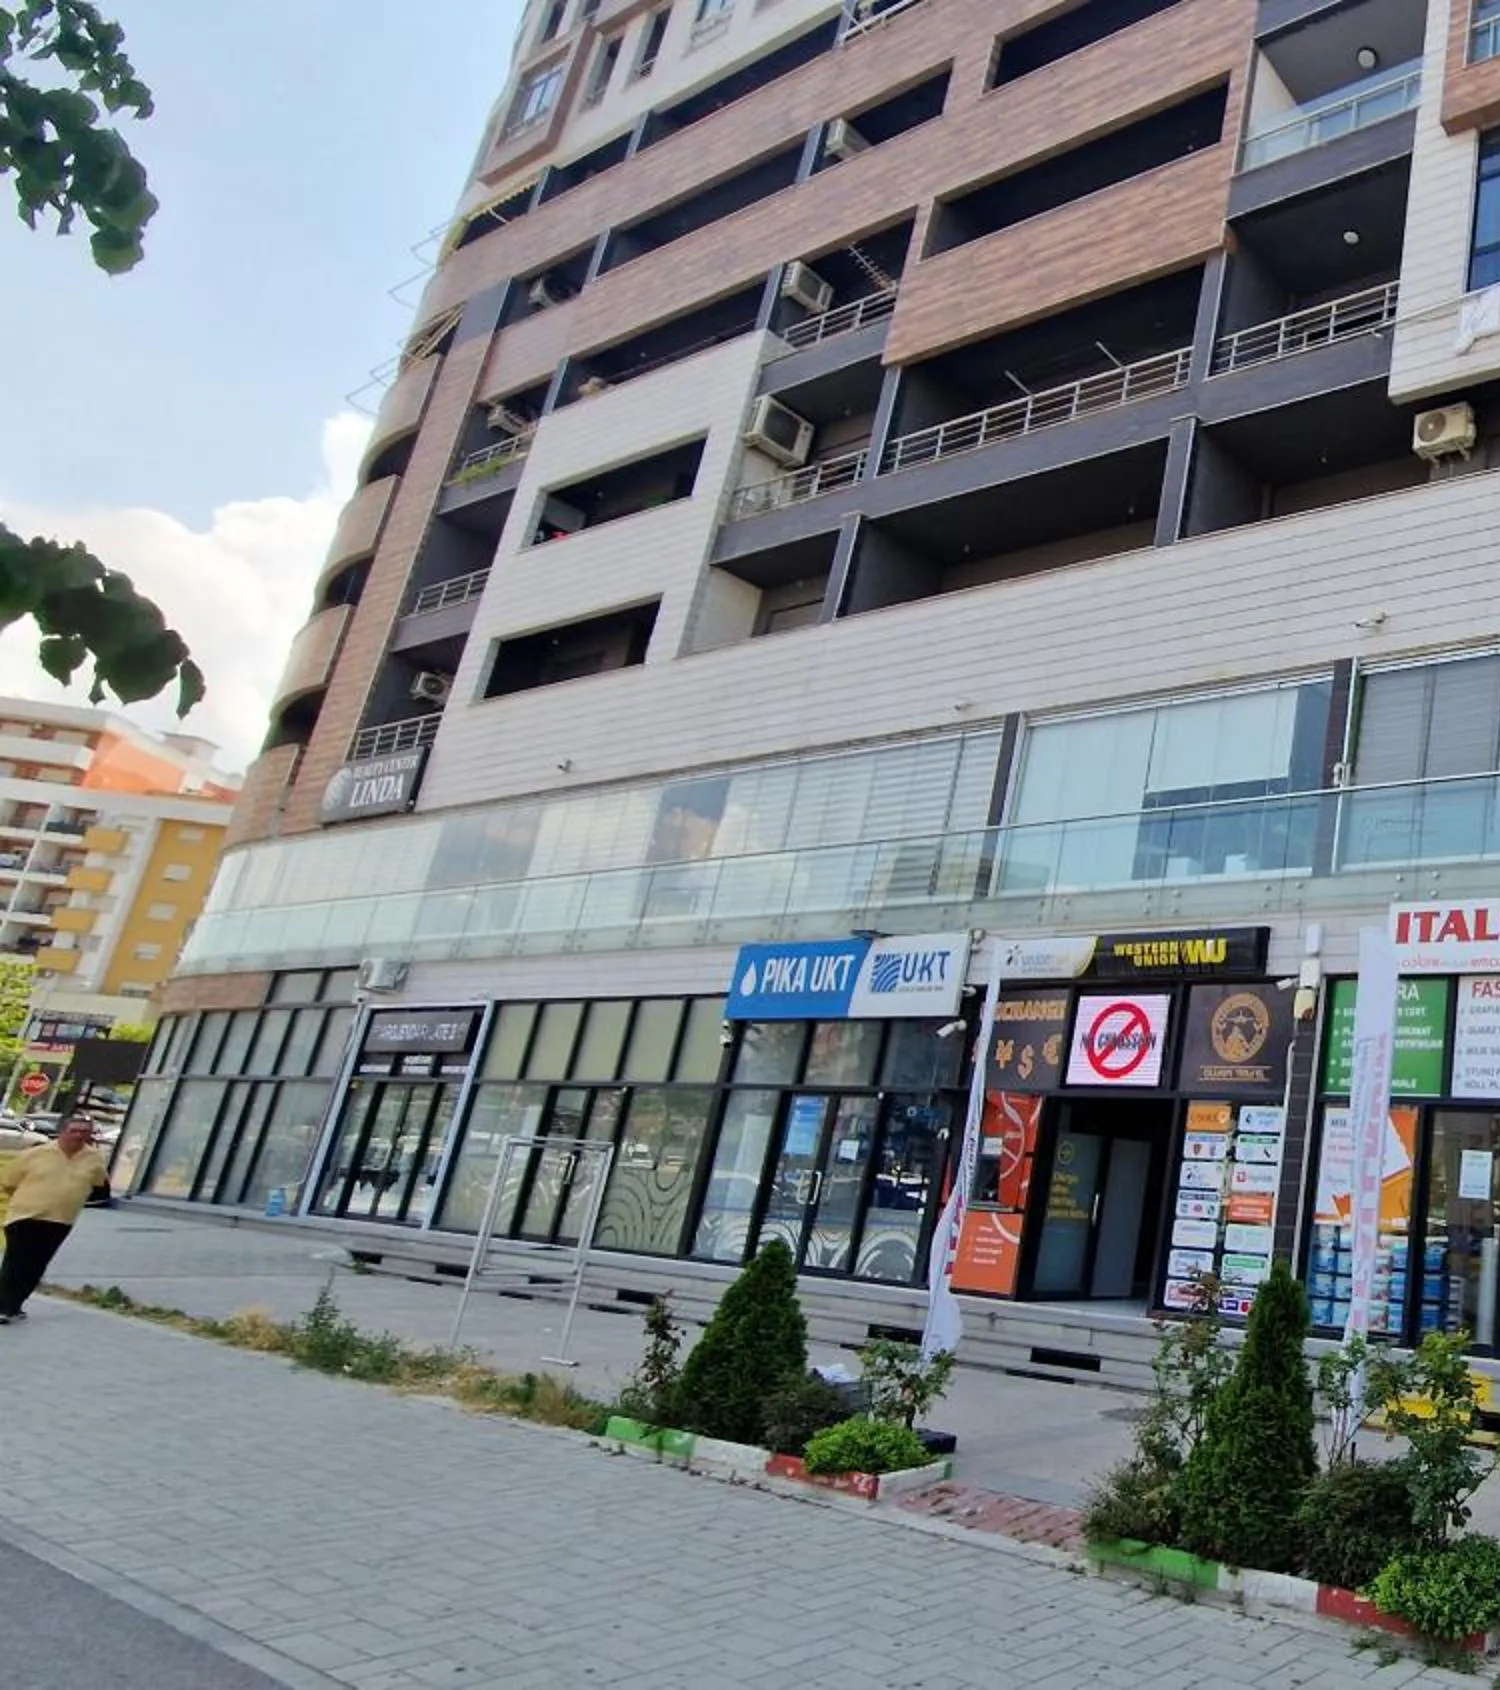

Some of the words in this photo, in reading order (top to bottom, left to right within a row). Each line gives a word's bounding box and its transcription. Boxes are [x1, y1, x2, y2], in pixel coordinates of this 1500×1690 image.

[349, 773, 405, 808] LINDA
[1113, 942, 1180, 958] WESTERN
[1132, 953, 1180, 968] UNION
[760, 957, 807, 994] PIKA
[810, 954, 856, 992] UKT
[902, 951, 951, 983] UKT
